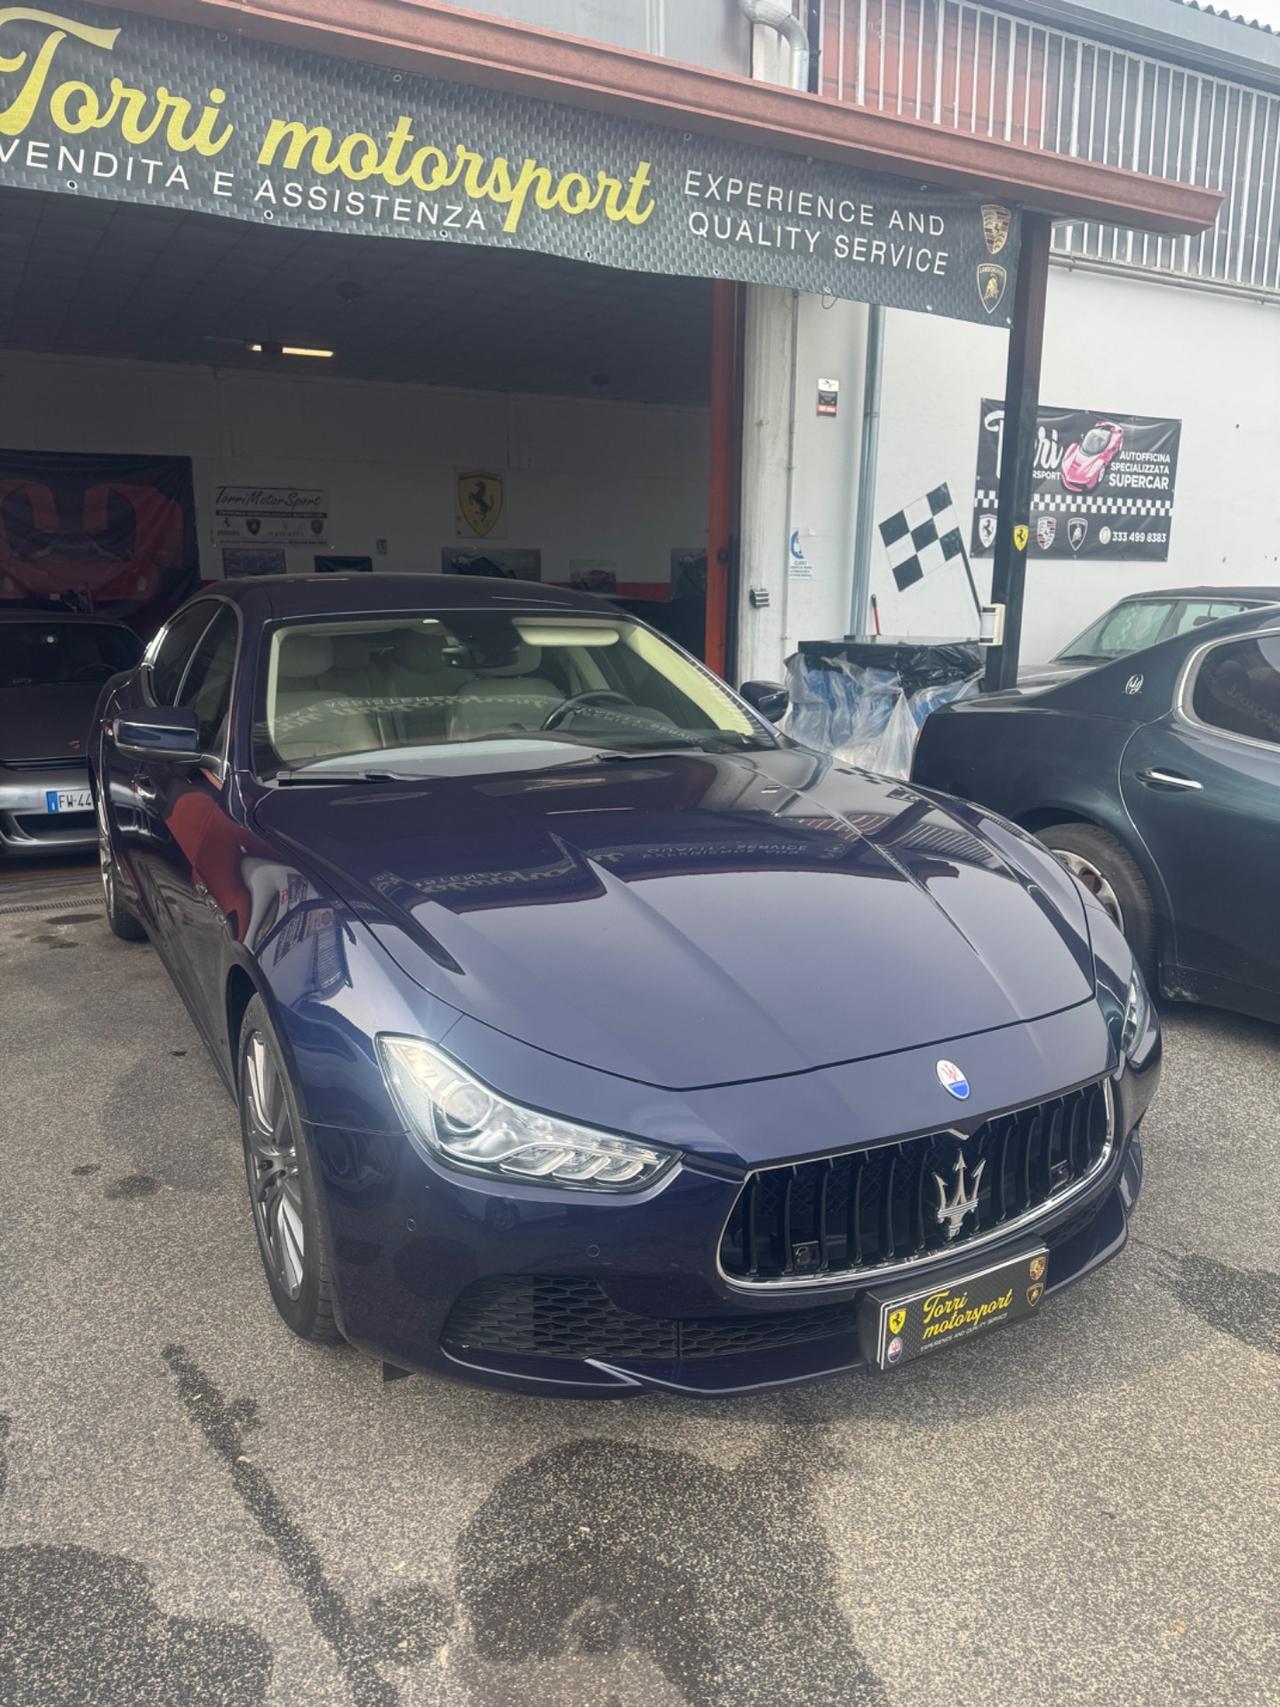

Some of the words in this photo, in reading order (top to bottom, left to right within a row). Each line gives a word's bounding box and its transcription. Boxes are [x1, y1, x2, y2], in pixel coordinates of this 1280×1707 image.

[0, 7, 234, 157] Torri
[256, 115, 655, 234] motorsport
[0, 139, 190, 191] VENDITA
[212, 170, 235, 198] E
[254, 178, 486, 231] ASSISTENZA
[684, 169, 875, 226] EXPERIENCE
[888, 209, 946, 237] AND
[688, 210, 822, 254] QUALITY
[834, 234, 949, 276] SERVICE
[1110, 462, 1170, 475] SPECIALIZZATA
[1119, 450, 1171, 464] AUTOFFICINA
[1032, 469, 1061, 481] RSPORT
[1108, 473, 1169, 490] SUPERCAR
[1111, 531, 1129, 542] 333
[1129, 531, 1146, 543] 499
[922, 1288, 1014, 1340] motorsport
[923, 1290, 969, 1325] Torri
